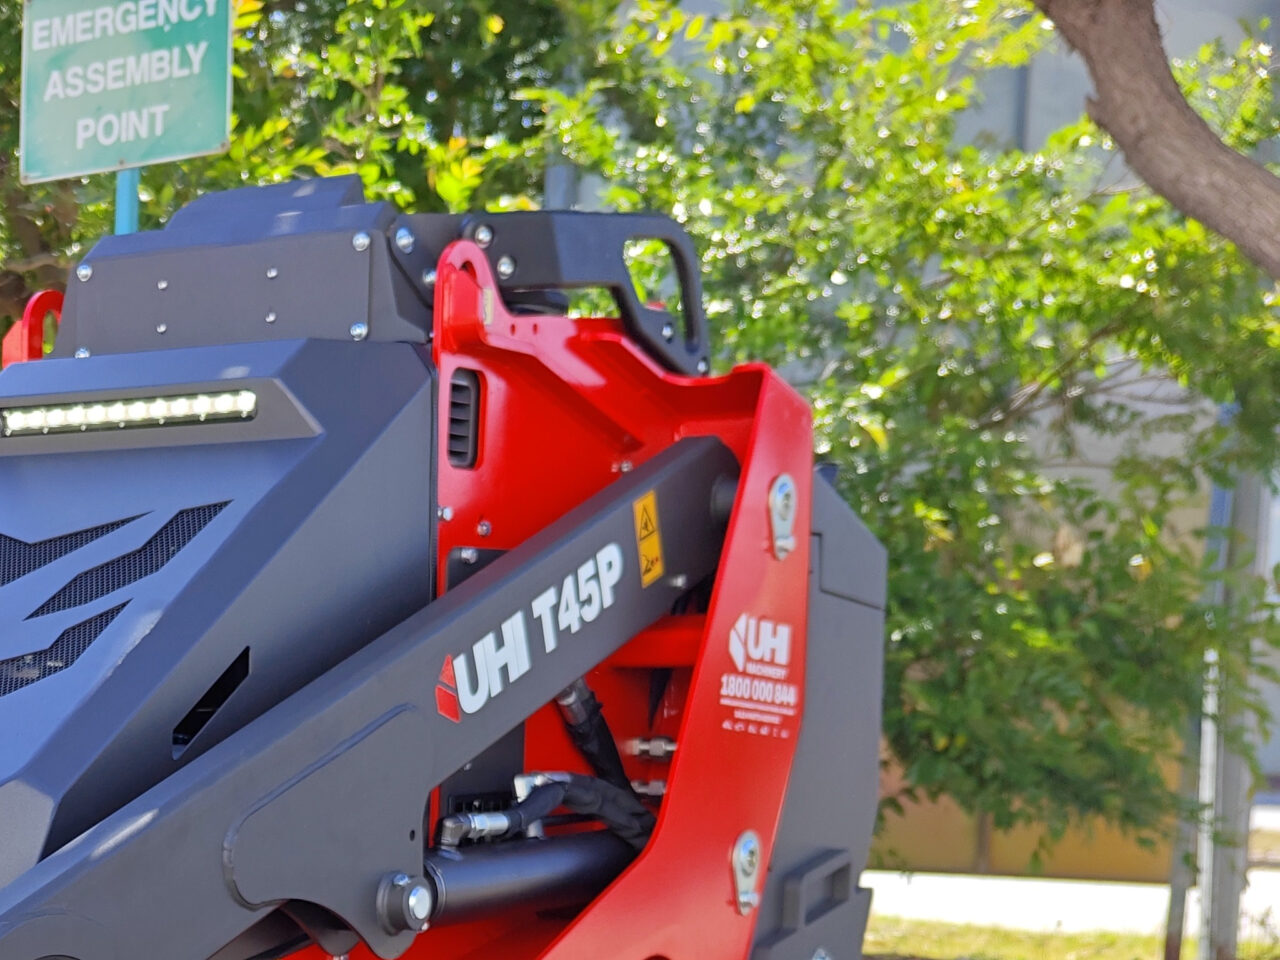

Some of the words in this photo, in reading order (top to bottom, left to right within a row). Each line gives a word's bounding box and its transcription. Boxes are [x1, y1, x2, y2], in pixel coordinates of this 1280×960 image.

[43, 41, 209, 102] ASSEMBLY
[76, 104, 169, 149] POINT
[531, 543, 624, 654] T45P
[720, 673, 751, 699] 1800
[751, 678, 773, 703] 000
